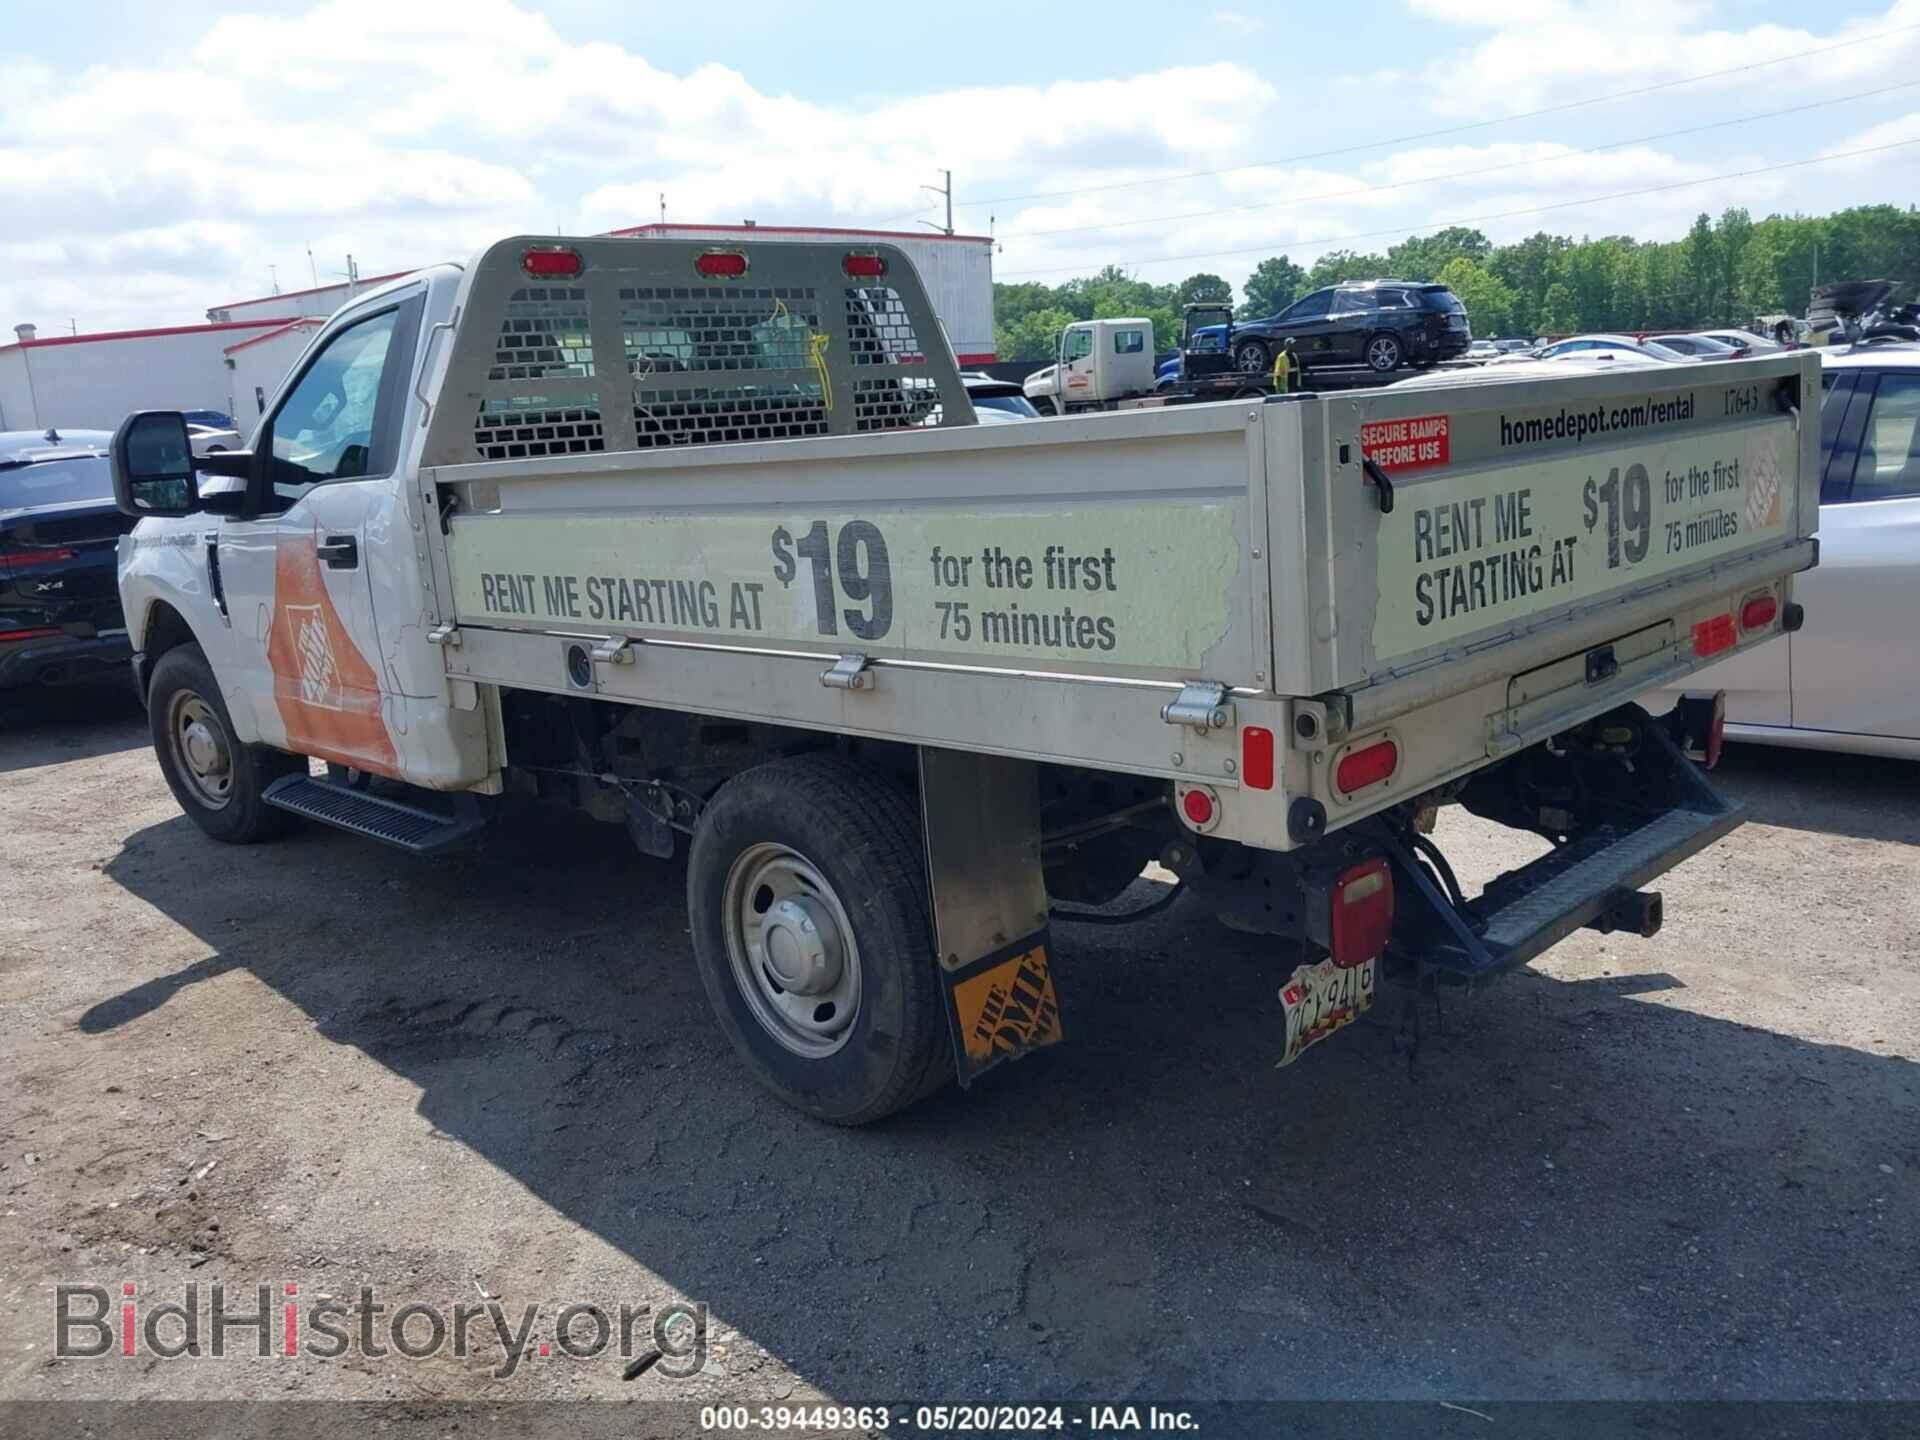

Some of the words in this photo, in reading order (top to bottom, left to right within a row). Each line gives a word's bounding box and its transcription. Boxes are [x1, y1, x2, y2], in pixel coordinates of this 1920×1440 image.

[1501, 393, 1695, 446] homedepot.com/rental
[1723, 386, 1758, 416] 17643
[1362, 424, 1407, 446] SECURE
[1409, 419, 1447, 439] RAMPS
[1371, 445, 1416, 466] BEFORE
[1419, 440, 1440, 461] USE
[1665, 470, 1684, 502] for
[1689, 466, 1709, 497] the
[1714, 457, 1739, 492] first
[1415, 497, 1486, 563] RENT
[1496, 488, 1532, 542] ME
[1583, 462, 1651, 569] $19
[1664, 522, 1681, 553] 75
[1685, 510, 1738, 548] minutes
[772, 519, 893, 640] $19
[930, 546, 973, 588] for
[978, 547, 1034, 589] the
[1043, 546, 1118, 592] first
[1416, 542, 1543, 626] STARTING
[1551, 536, 1577, 585] AT
[482, 573, 537, 615] RENT
[541, 576, 582, 619] ME
[587, 577, 721, 628] STARTING
[729, 583, 764, 632] AT
[935, 600, 972, 642] 75
[981, 602, 1117, 652] minutes
